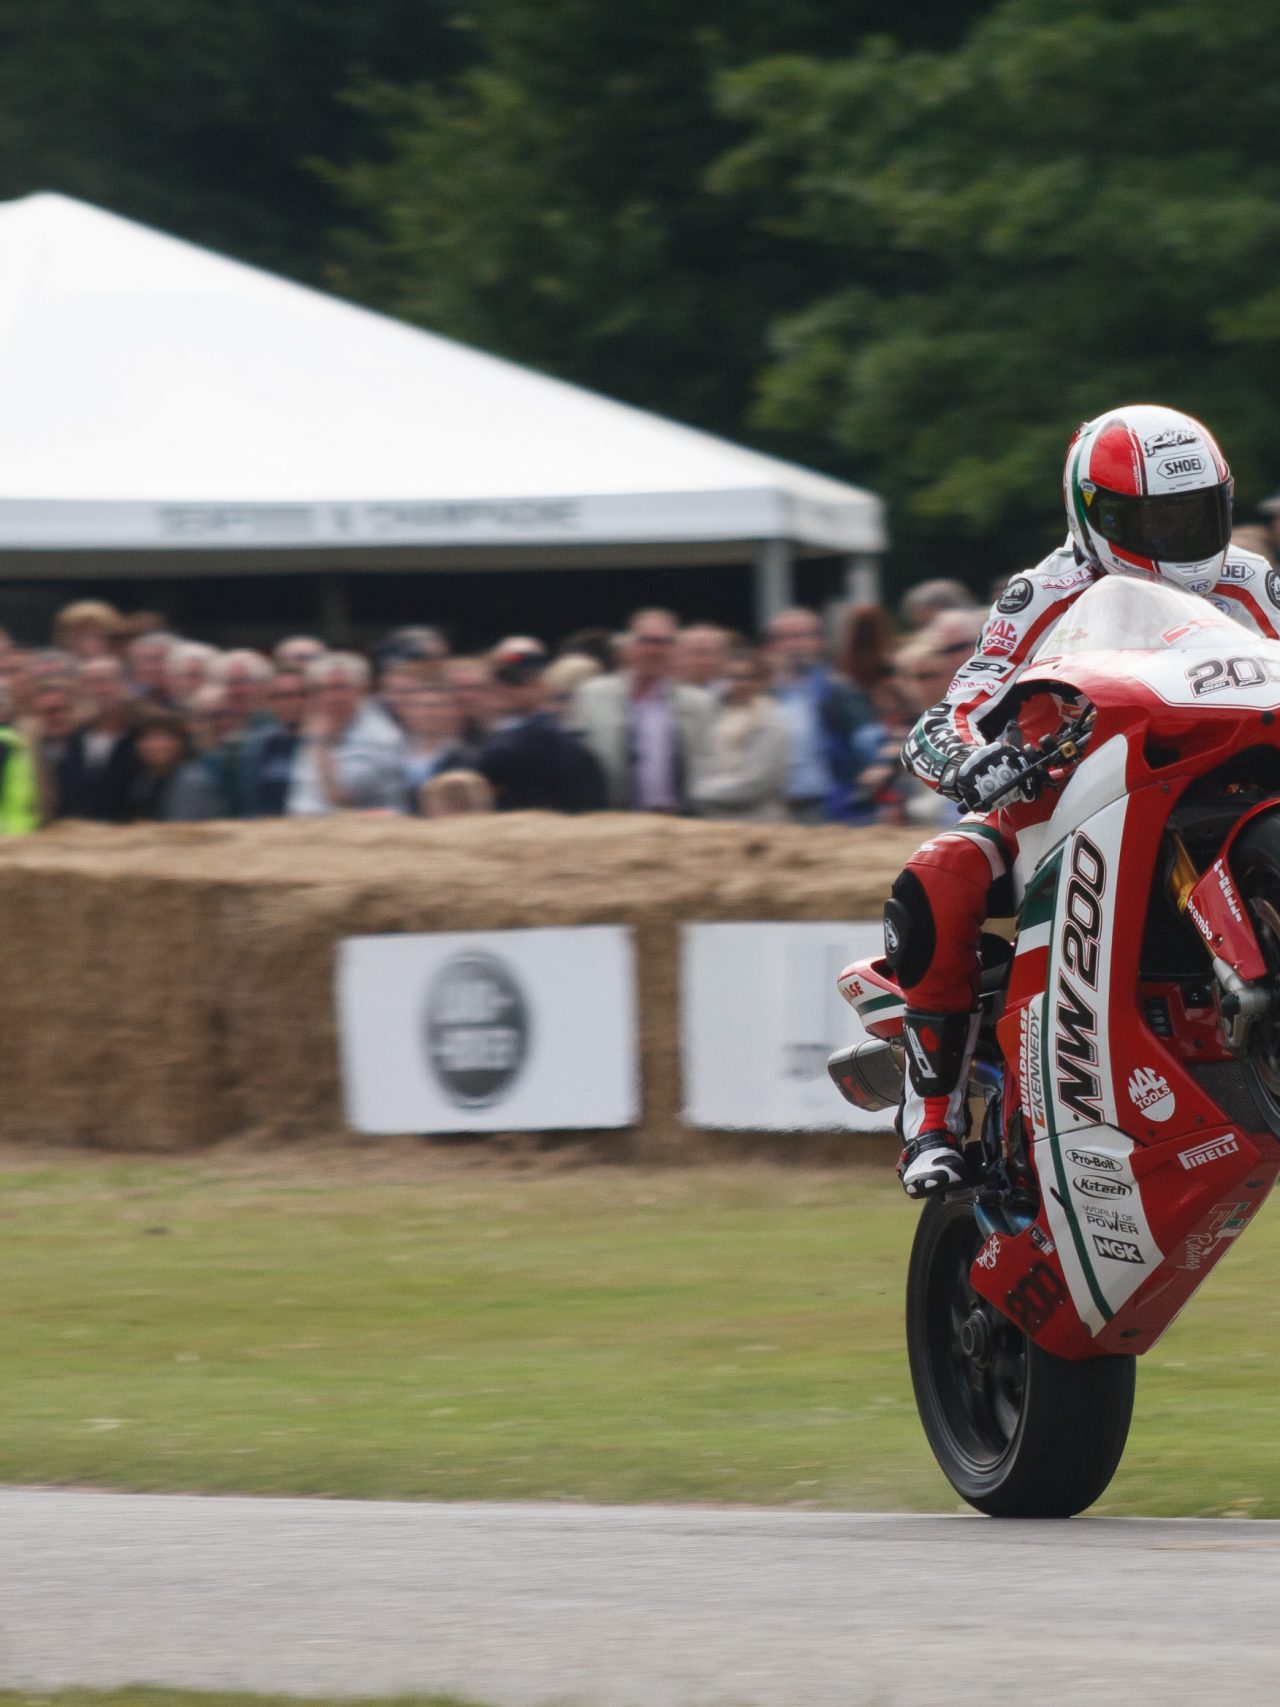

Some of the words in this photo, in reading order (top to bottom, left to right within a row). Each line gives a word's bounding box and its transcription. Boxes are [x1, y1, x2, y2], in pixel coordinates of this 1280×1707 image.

[1165, 458, 1202, 476] SHOEI
[1187, 895, 1213, 941] brembo
[1019, 1006, 1032, 1118] BUILDBASE
[1029, 1008, 1043, 1105] KENNEDY
[1128, 1067, 1168, 1104] MAC
[1136, 1085, 1171, 1110] TOOLS
[1071, 1151, 1116, 1170] Pro-Bolt
[1177, 1133, 1240, 1170] PIRELLI
[1082, 1205, 1119, 1218] WORLD
[1121, 1213, 1135, 1223] OF
[1086, 1215, 1139, 1235] POWER
[1093, 1236, 1142, 1263] NGK
